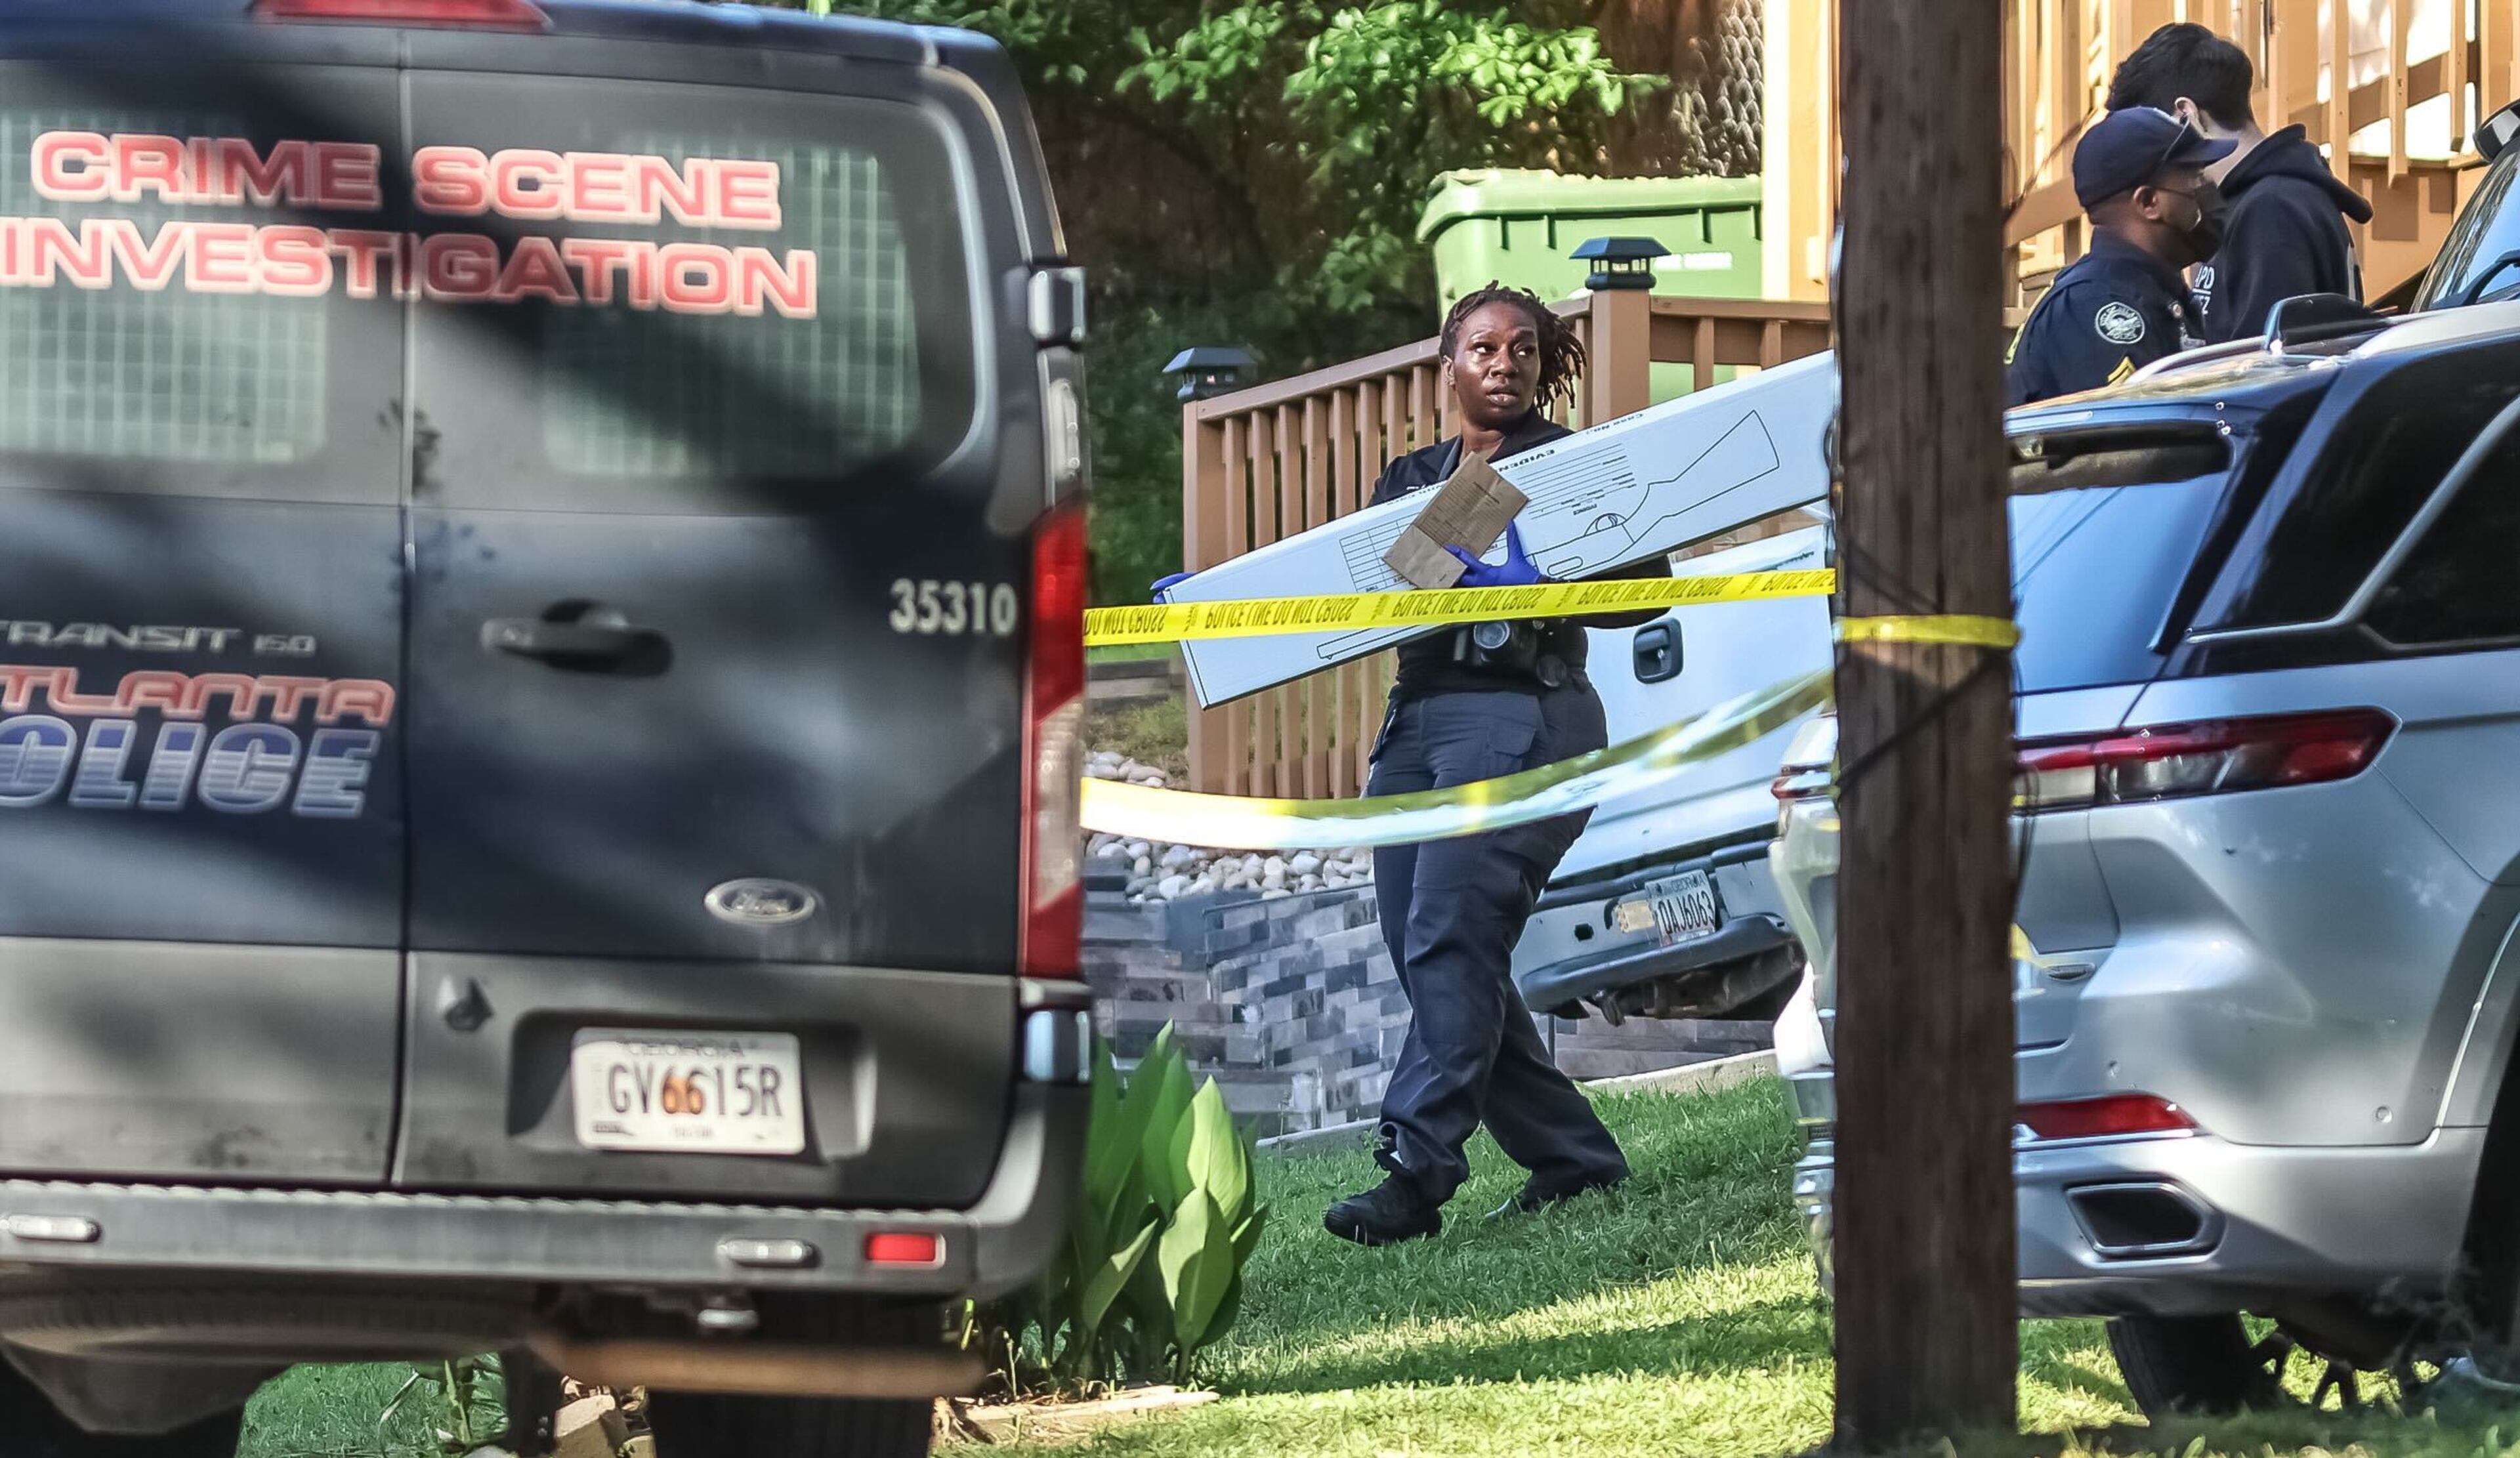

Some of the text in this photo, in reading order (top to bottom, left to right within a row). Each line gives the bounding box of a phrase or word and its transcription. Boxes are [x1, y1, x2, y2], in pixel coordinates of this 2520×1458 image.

[32, 131, 782, 231] CRIME SCENE
[0, 217, 817, 319] INVESTIGATION
[889, 577, 1017, 637] 35310
[608, 1064, 783, 1117] GV6615R
